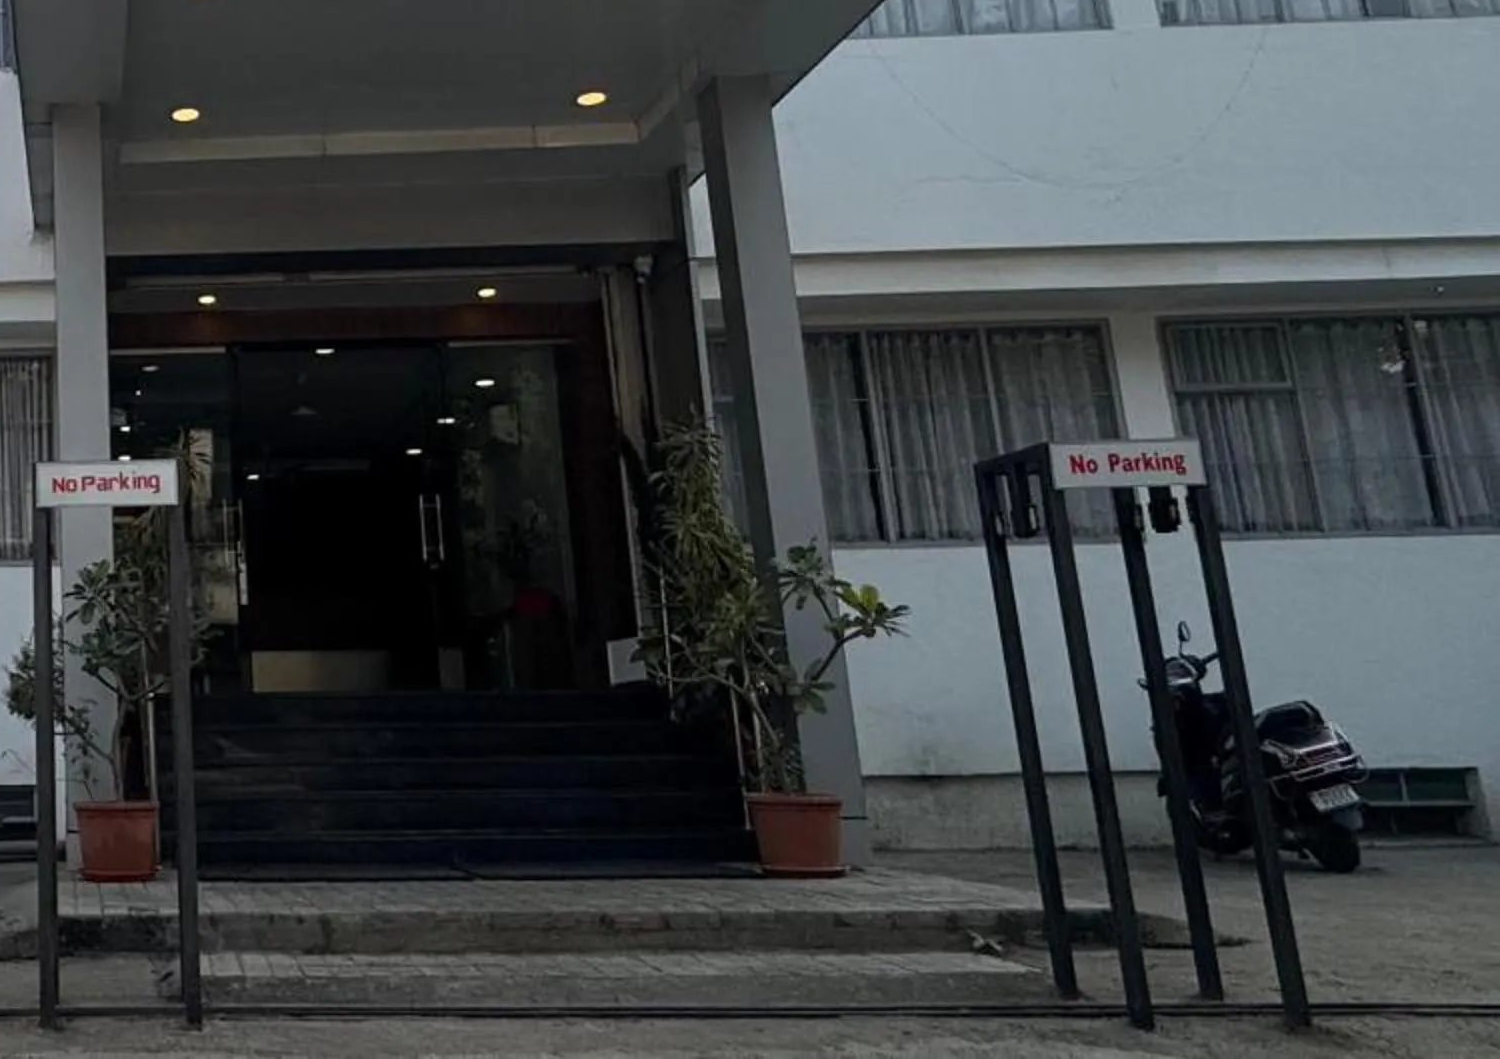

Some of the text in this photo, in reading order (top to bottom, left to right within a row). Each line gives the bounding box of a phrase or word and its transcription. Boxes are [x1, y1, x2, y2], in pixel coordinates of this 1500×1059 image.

[1069, 452, 1187, 475] No Parking
[52, 472, 160, 493] No Parking
